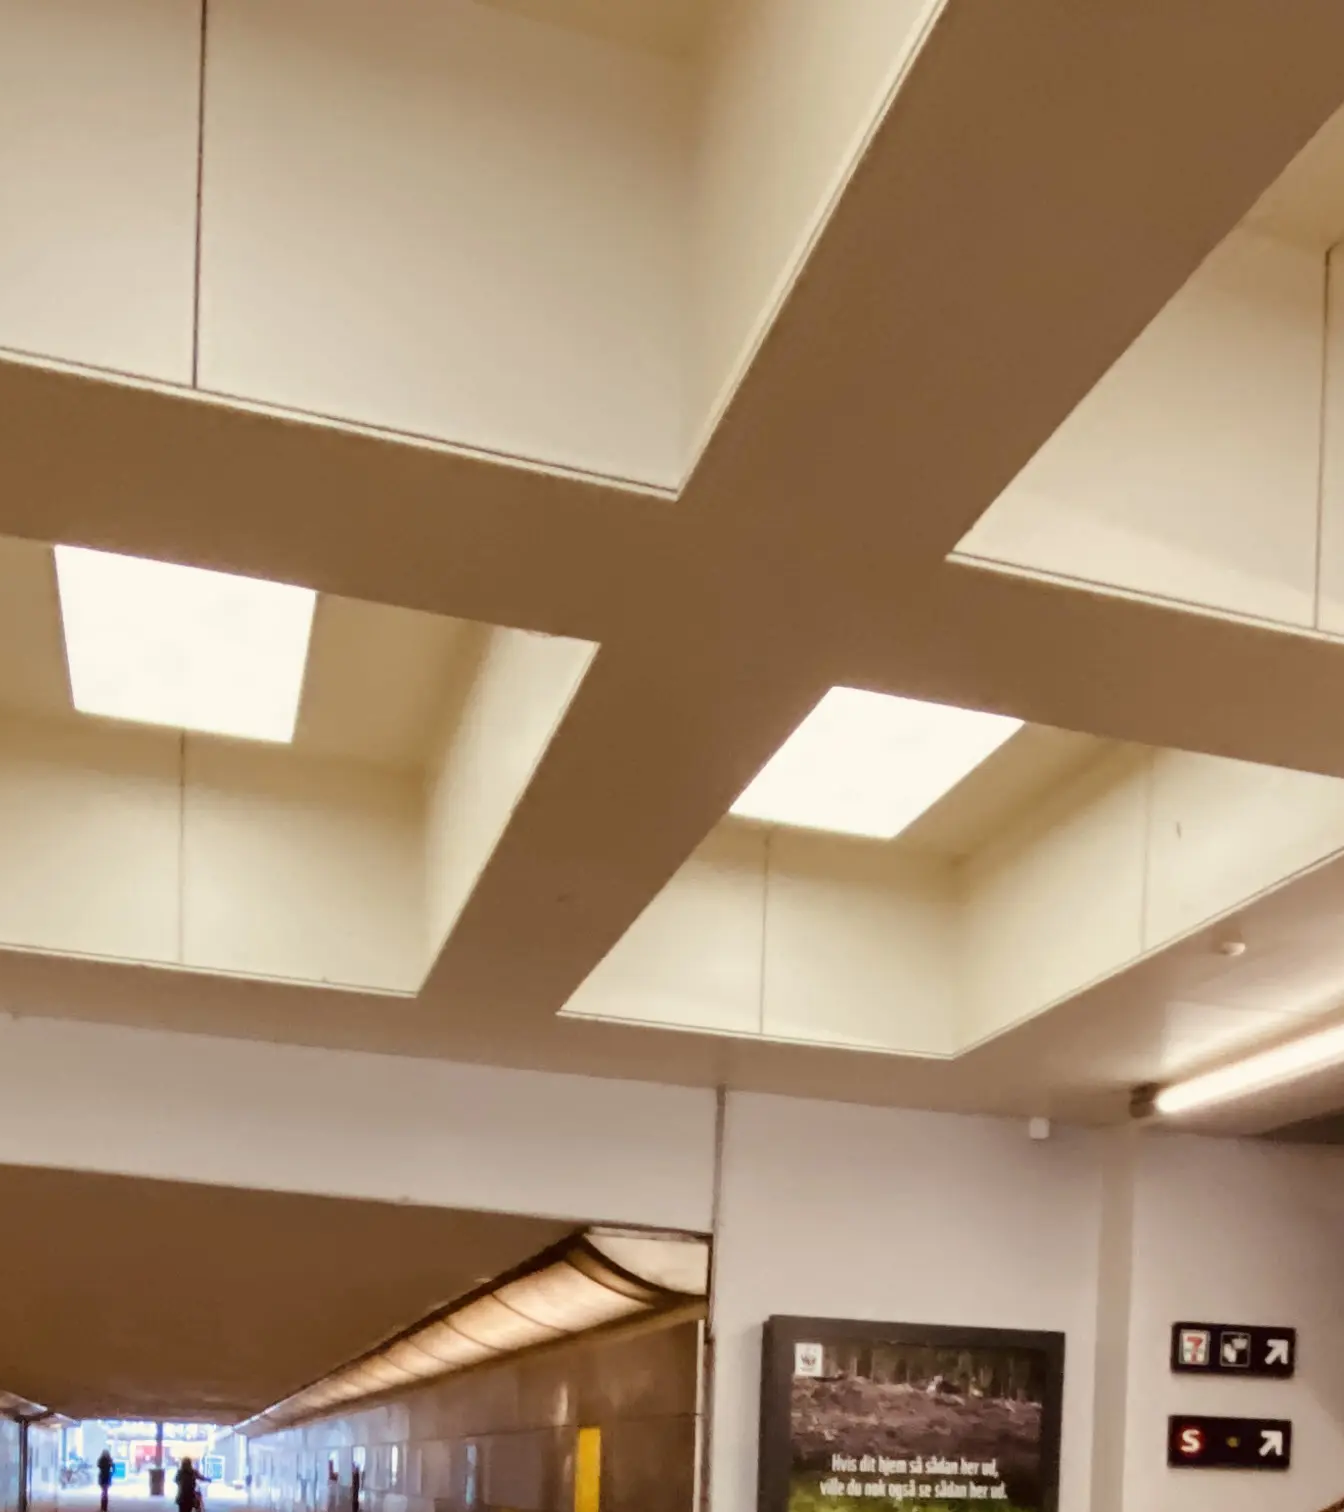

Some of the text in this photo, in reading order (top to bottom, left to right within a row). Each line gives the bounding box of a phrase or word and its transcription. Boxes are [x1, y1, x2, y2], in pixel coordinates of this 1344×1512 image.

[1181, 1429, 1201, 1453] S
[832, 1453, 857, 1472] Hvis
[859, 1454, 876, 1472] dit
[878, 1455, 907, 1476] hjem
[908, 1455, 923, 1474] så
[925, 1456, 959, 1475] sådan
[960, 1457, 980, 1476] her
[820, 1477, 845, 1496] ville
[846, 1478, 862, 1497] du
[864, 1479, 886, 1497] nok
[888, 1479, 916, 1501] også
[918, 1484, 932, 1497] se
[934, 1480, 967, 1498] sådan
[969, 1481, 988, 1498] her
